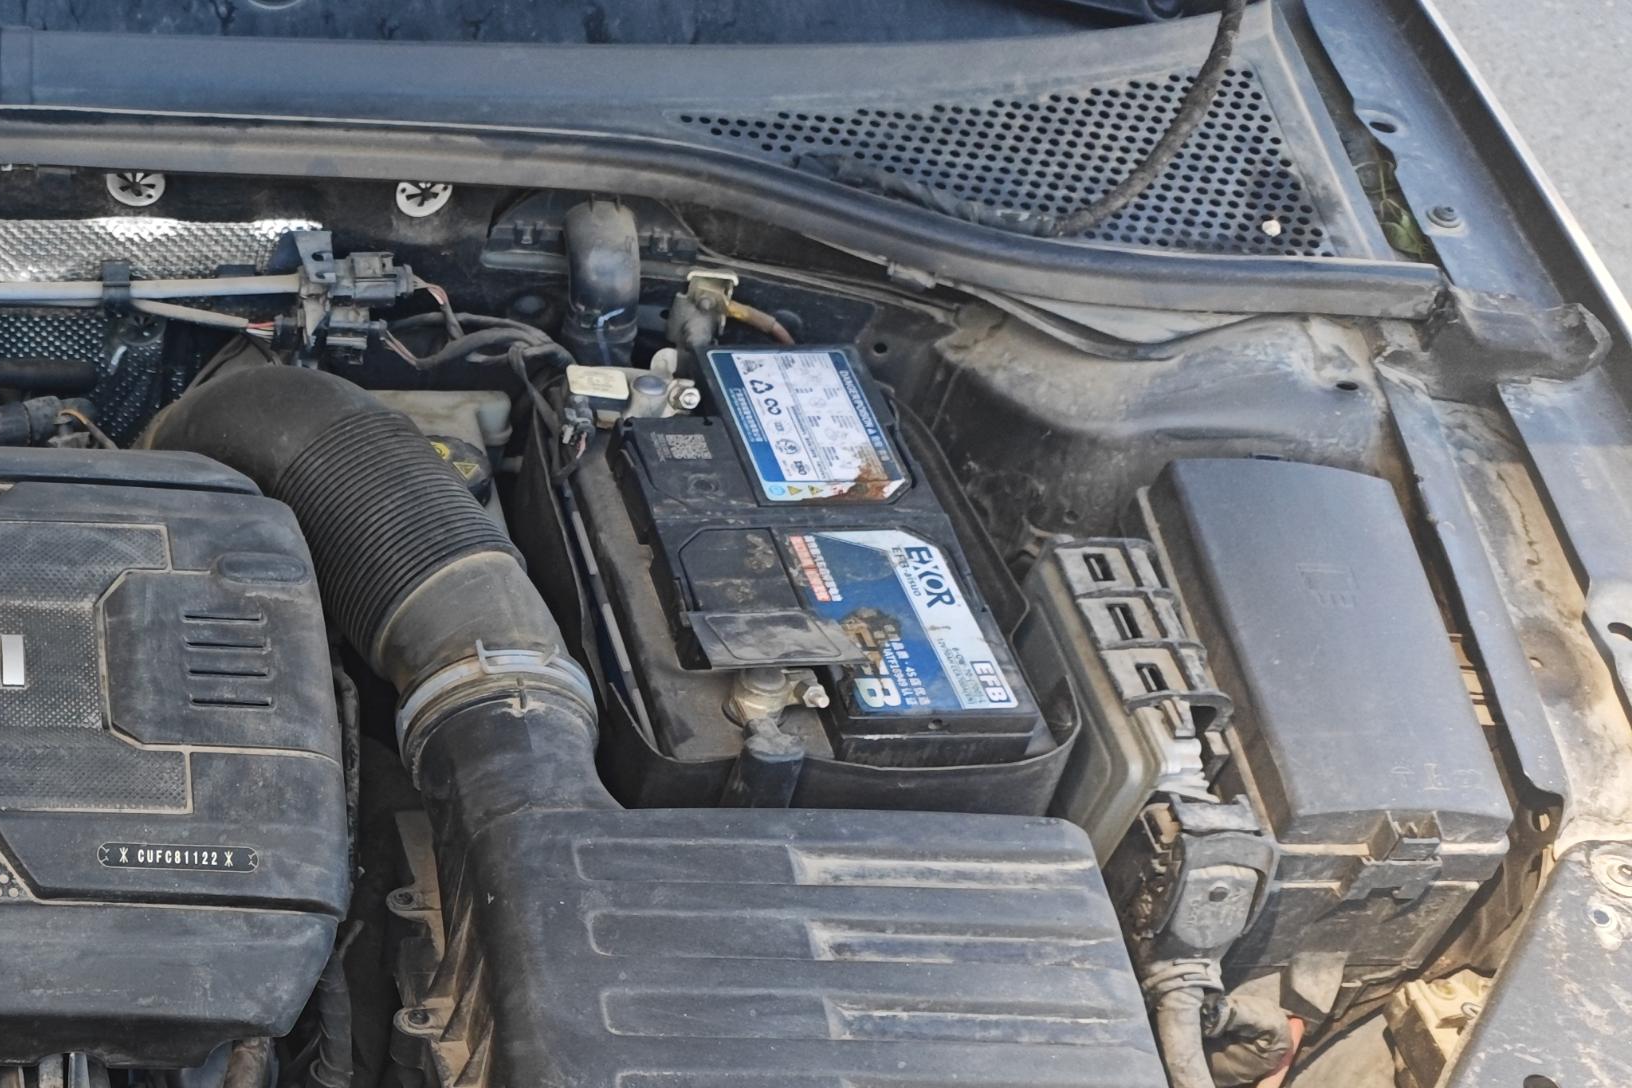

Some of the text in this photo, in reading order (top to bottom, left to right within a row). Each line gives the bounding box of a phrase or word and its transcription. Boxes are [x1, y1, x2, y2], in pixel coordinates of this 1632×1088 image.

[904, 546, 956, 608] EXOR
[973, 662, 1009, 702] EFB
[137, 849, 218, 866] CUFC81122
